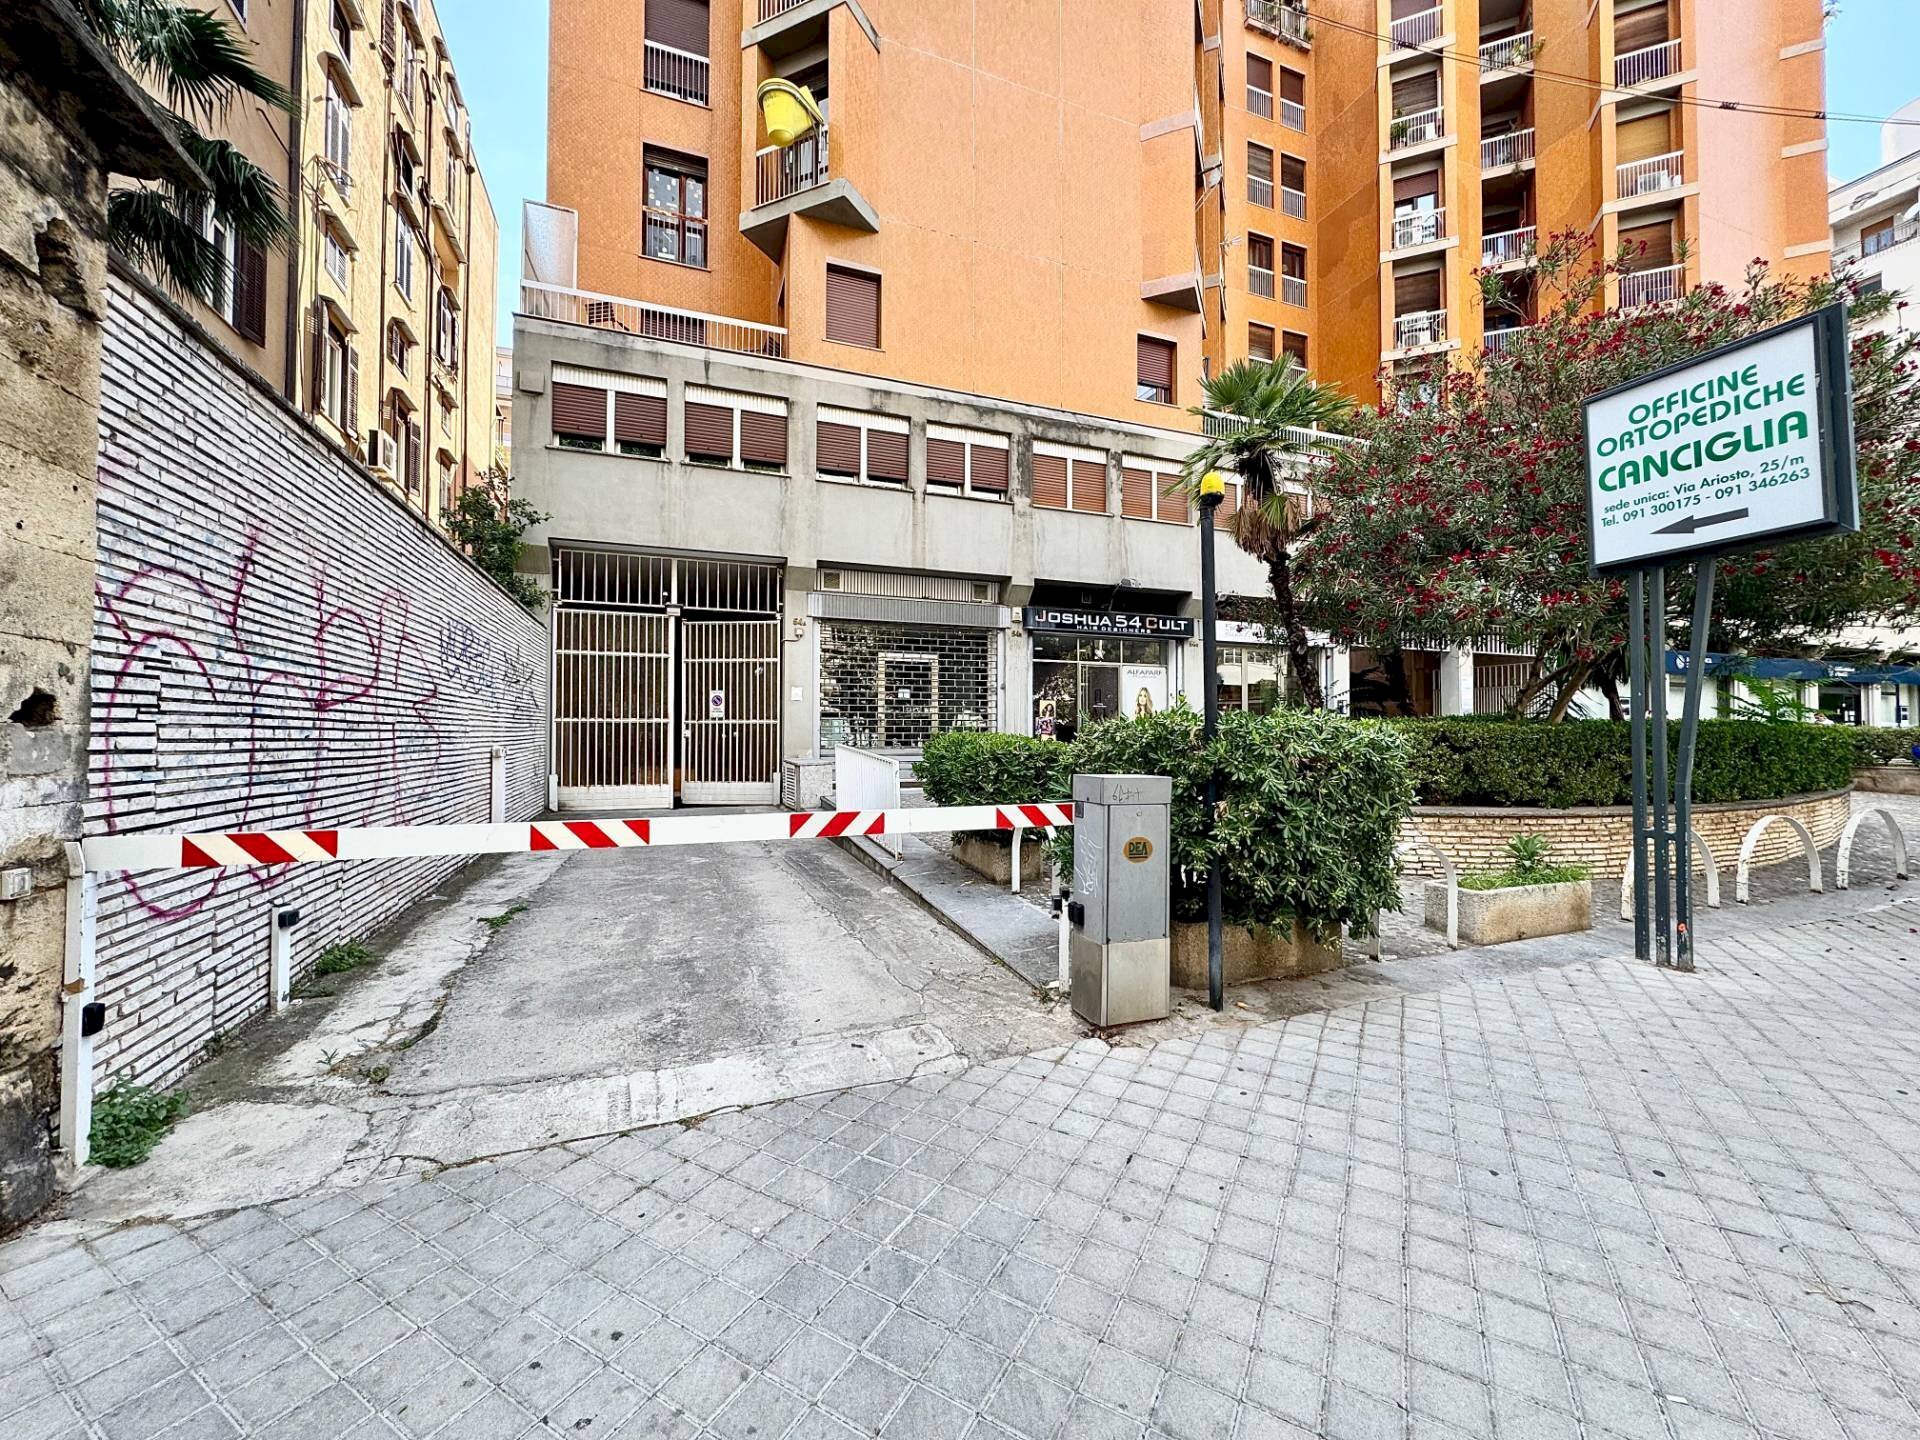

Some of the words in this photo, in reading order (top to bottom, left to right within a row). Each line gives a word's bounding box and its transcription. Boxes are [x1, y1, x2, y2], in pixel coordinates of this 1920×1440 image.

[1596, 373, 1806, 457] ORTOPEDICHE
[1628, 364, 1758, 425] OFFICINE
[1598, 410, 1809, 492] CANCIGLIA
[1601, 514, 1620, 528] Tel.
[1622, 508, 1645, 522] 091
[1650, 494, 1701, 516] 300175
[1715, 484, 1741, 500] 091
[1748, 467, 1811, 492] 346263
[1604, 499, 1630, 514] sede
[1633, 490, 1670, 506] unica:
[1673, 482, 1696, 496] Via
[1700, 470, 1755, 489] Ariosto,
[1759, 455, 1805, 474] 25/m
[1034, 609, 1112, 627] JOSHUA
[1115, 615, 1142, 628] 54
[1145, 616, 1189, 631] CULT
[1100, 626, 1152, 634] DESIGNERS
[1128, 841, 1148, 855] DEA
